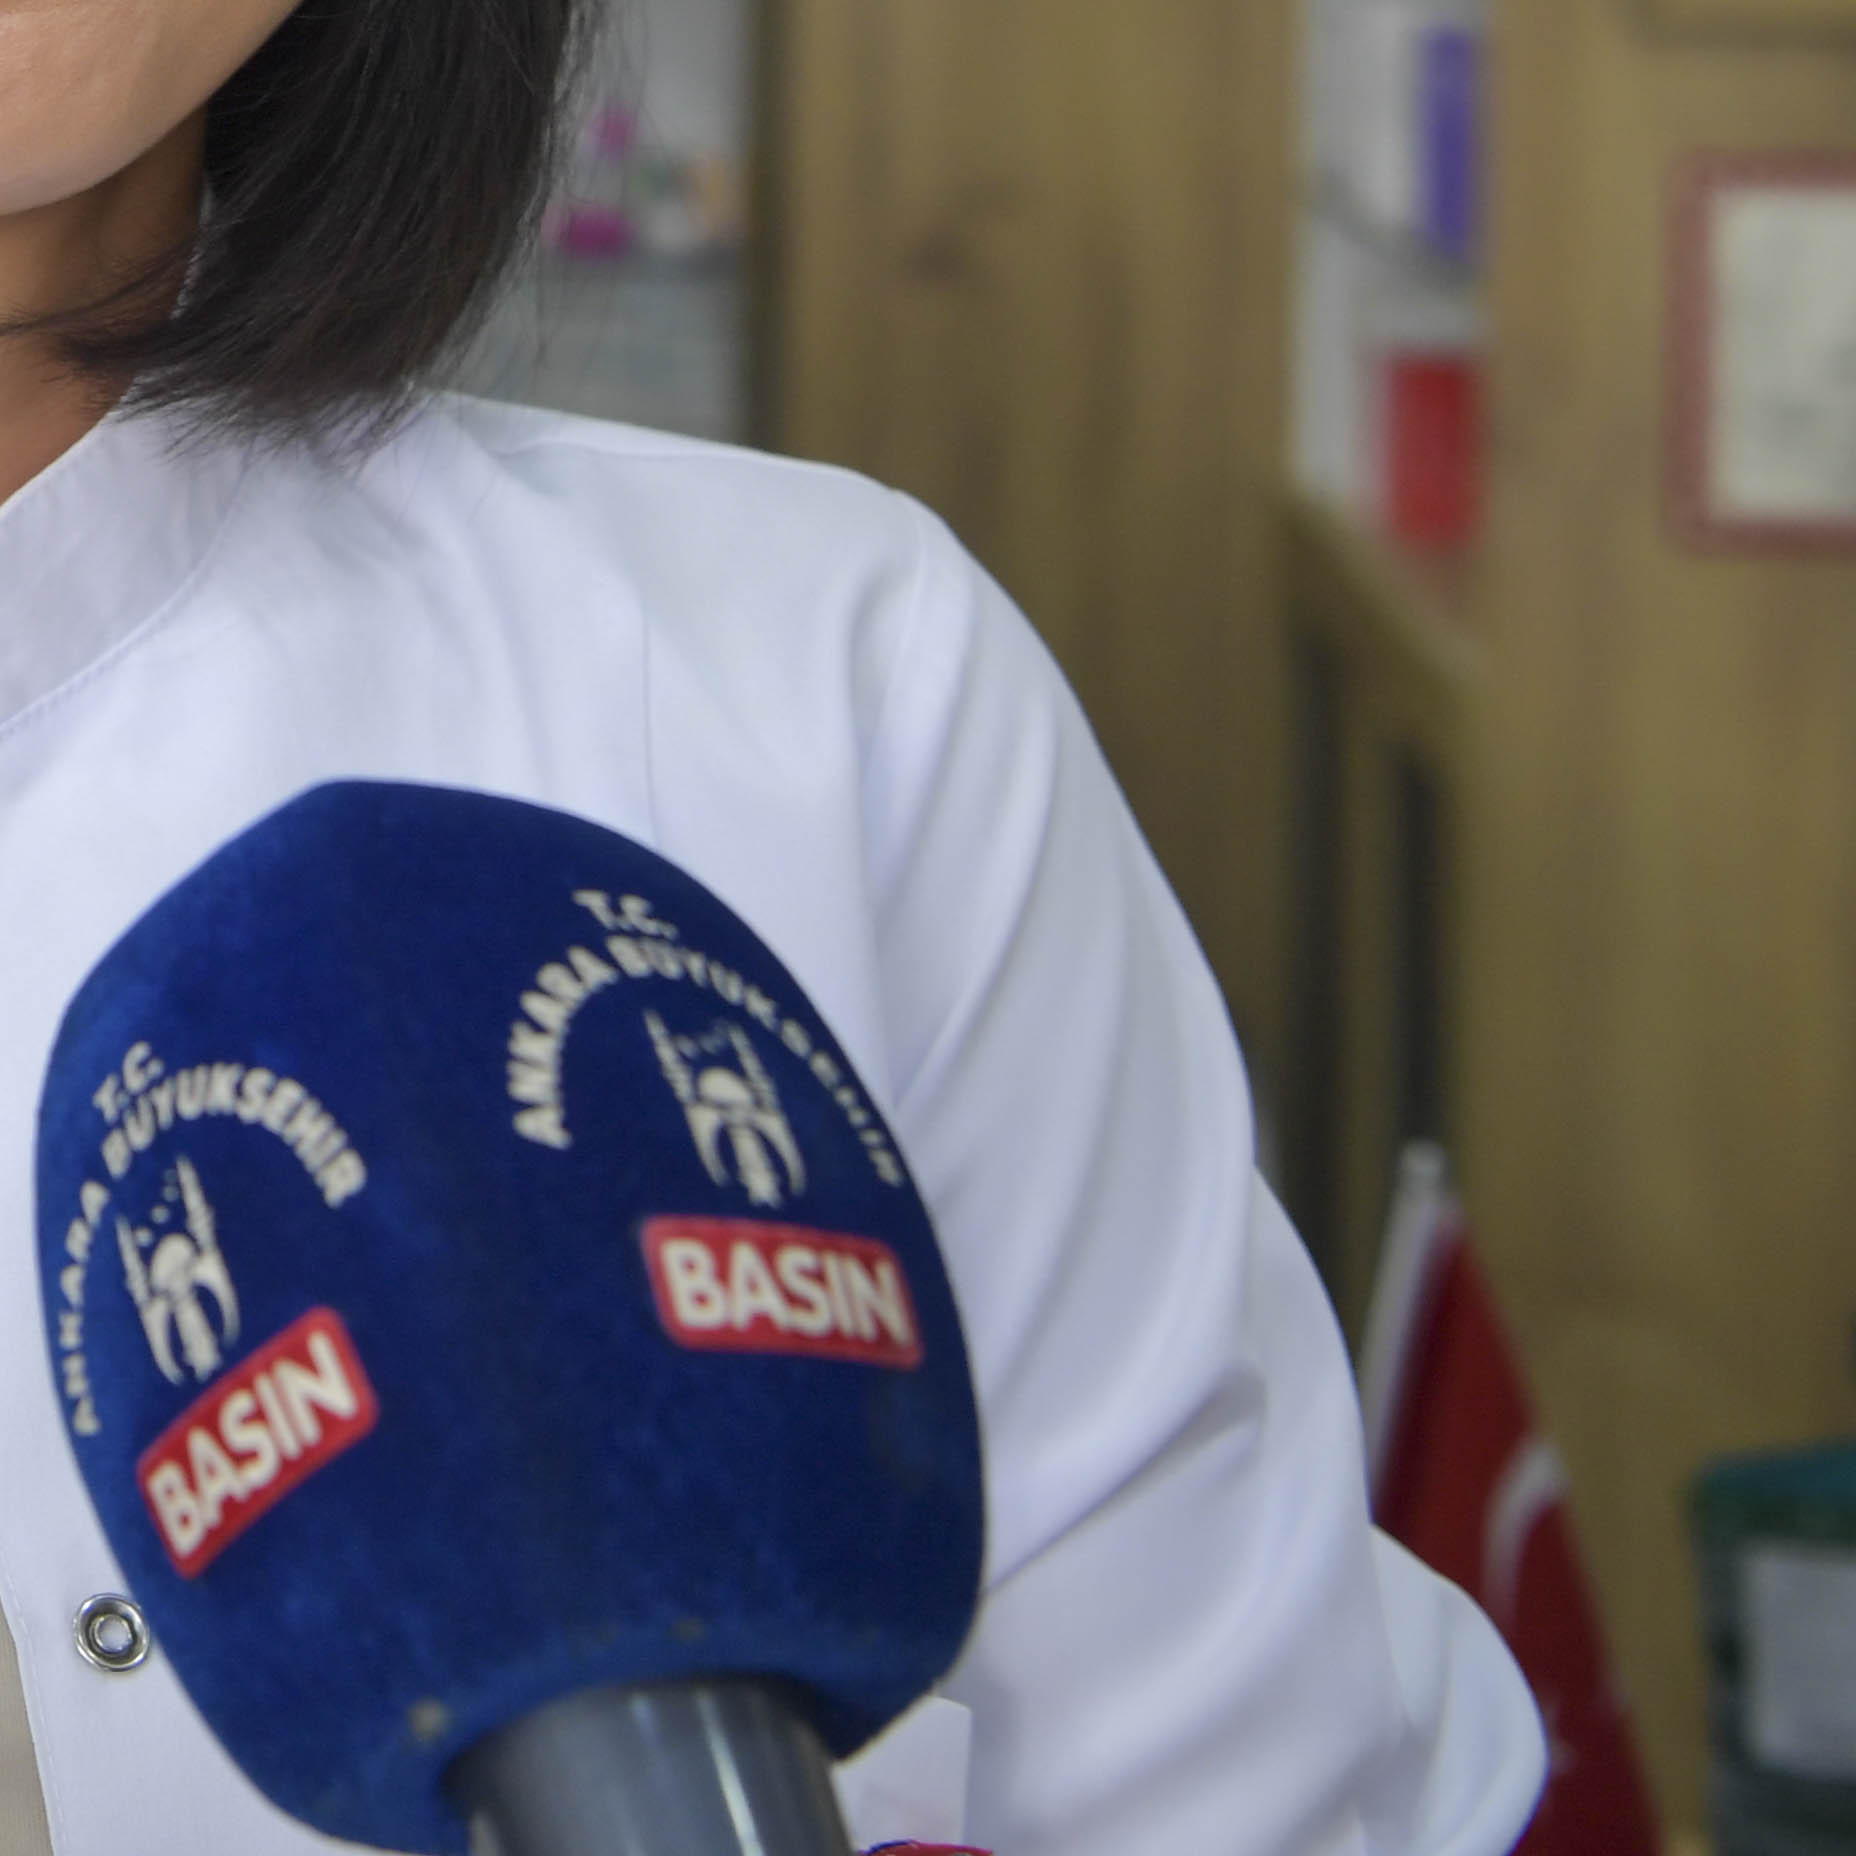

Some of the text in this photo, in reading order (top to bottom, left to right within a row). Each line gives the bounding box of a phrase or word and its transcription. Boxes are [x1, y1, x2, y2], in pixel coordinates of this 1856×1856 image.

[506, 946, 621, 1148] ANKARA
[661, 1237, 915, 1349] BASIN
[144, 1329, 359, 1557] BASIN
